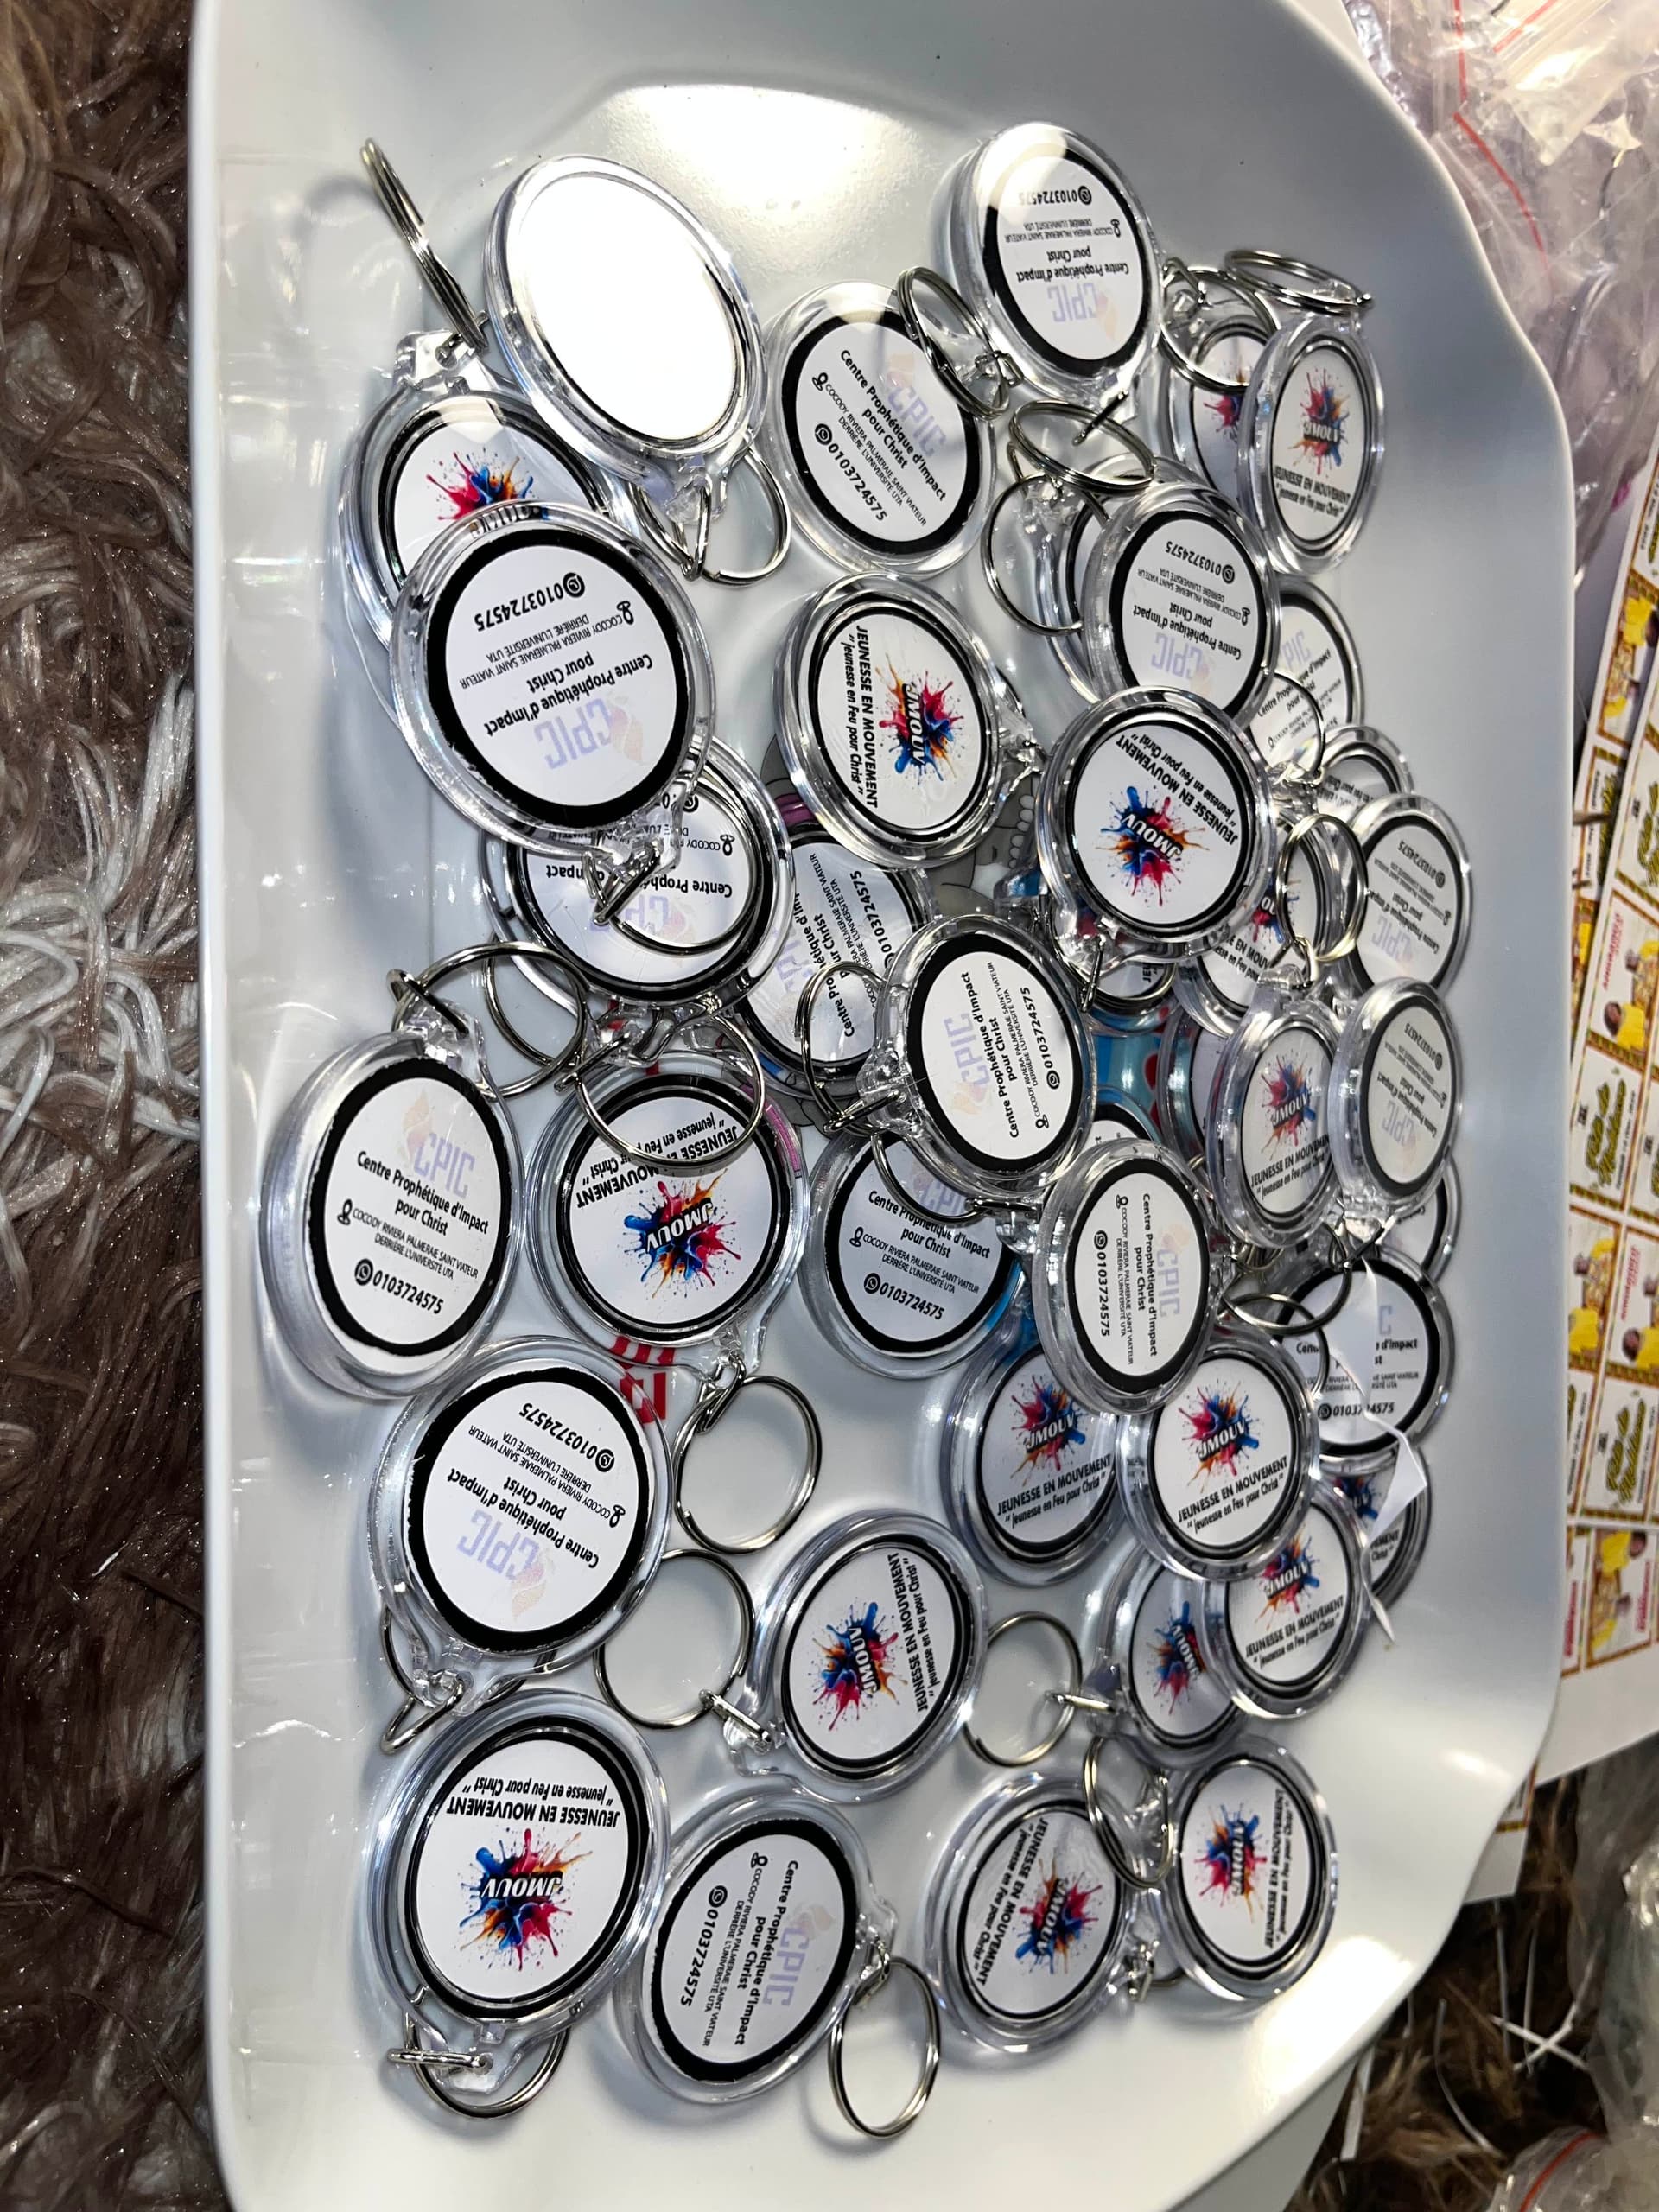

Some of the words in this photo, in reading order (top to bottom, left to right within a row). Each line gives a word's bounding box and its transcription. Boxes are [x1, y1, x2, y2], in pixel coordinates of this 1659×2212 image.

[842, 350, 868, 388] Centre
[866, 385, 913, 454] Prophétique
[912, 454, 946, 500] d'Impact
[861, 408, 885, 435] pour
[883, 435, 907, 469] Christ
[887, 389, 947, 455] CPIC
[828, 442, 887, 520] 0103724575
[474, 582, 563, 631] 0103724575
[591, 614, 622, 634] COCODY
[518, 639, 562, 664] PALMERAIE
[561, 626, 590, 645] RIVIERA
[485, 649, 504, 662] UTA
[494, 657, 518, 674] SAINT
[564, 650, 594, 675] pour
[613, 654, 652, 677] Centre
[856, 625, 872, 691] JEUNESSE
[458, 667, 494, 688] VIATEUR
[525, 667, 563, 693] Christ
[540, 669, 615, 709] Prophétique
[483, 702, 539, 736] d'Impact
[861, 695, 873, 714] EN
[535, 698, 609, 769] CPIC
[905, 683, 925, 766] JMOUV
[861, 717, 878, 808] MOUVEMENT
[1116, 730, 1180, 793] MOUVEMENT
[1178, 787, 1194, 807] EN
[1120, 811, 1182, 861] JMOUV
[1192, 800, 1238, 843] JEUNESSE
[830, 879, 840, 895] UTA
[849, 870, 892, 952] 0103724575
[814, 913, 834, 948] Christ
[961, 970, 983, 1022] d'Impact
[836, 1000, 855, 1038] Centre
[988, 1016, 1005, 1051] Christ
[1020, 987, 1053, 1068] 0103724575
[944, 1013, 989, 1084] CPIC
[979, 1025, 1007, 1097] Prophétique
[1001, 1054, 1017, 1082] pour
[1002, 1099, 1019, 1138] Centre
[680, 1126, 738, 1160] JEUNESSE
[413, 1136, 475, 1198] CPIC
[575, 1164, 659, 1208] MOUVEMENT
[589, 1157, 618, 1179] Christ
[358, 1149, 391, 1180] Centre
[391, 1168, 449, 1213] Prophétique
[450, 1203, 488, 1235] d'Impact
[393, 1198, 420, 1220] pour
[420, 1209, 448, 1236] Christ
[645, 1202, 712, 1252] JMOUV
[869, 1190, 899, 1214] Centre
[953, 1232, 989, 1259] d'Impact
[352, 1207, 381, 1229] COCODY
[380, 1222, 404, 1242] RIVIERA
[404, 1234, 438, 1258] PALMERAIE
[438, 1251, 456, 1267] SAINT
[456, 1260, 478, 1278] VIATEUR
[899, 1228, 924, 1245] pour
[925, 1236, 950, 1258] Christ
[1133, 1246, 1142, 1274] pour
[442, 1266, 454, 1279] UTA
[1144, 1233, 1154, 1304] Prophétique
[1157, 1250, 1180, 1317] CPIC
[372, 1270, 443, 1313] 0103724575
[879, 1282, 944, 1319] 0103724575
[1096, 1251, 1109, 1337] 0103724575
[1136, 1276, 1145, 1311] Christ
[1147, 1306, 1158, 1357] d'Impact
[468, 1425, 498, 1449] VIATEUR
[502, 1431, 517, 1446] UTA
[518, 1402, 597, 1459] 0103724575
[497, 1444, 519, 1462] SAINT
[518, 1456, 558, 1485] PALMERAIE
[447, 1467, 498, 1507] d'Impact
[503, 1476, 537, 1505] Christ
[557, 1479, 582, 1501] RIVIERA
[997, 1485, 1041, 1516] JEUNESSE
[1042, 1478, 1055, 1496] EN
[1057, 1454, 1113, 1490] MOUVEMENT
[1178, 1491, 1220, 1523] JEUNESSE
[1220, 1484, 1234, 1500] EN
[1235, 1456, 1290, 1493] MOUVEMENT
[498, 1497, 565, 1548] Prophétique
[537, 1497, 567, 1520] pour
[582, 1496, 610, 1518] COCODY
[456, 1510, 538, 1575] CPIC
[565, 1538, 599, 1568] Centre
[887, 1548, 913, 1633] MOUVEMENT
[906, 1563, 919, 1592] Christ
[913, 1592, 927, 1615] pour
[904, 1633, 917, 1654] EN
[917, 1615, 928, 1635] Feu
[921, 1633, 931, 1646] en
[848, 1625, 877, 1694] JMOUV
[924, 1647, 941, 1688] jeunesse
[907, 1652, 929, 1712] JEUNESSE
[473, 1777, 503, 1796] Christ
[505, 1777, 531, 1793] pour
[531, 1782, 550, 1800] Feu
[550, 1784, 563, 1796] en
[565, 1784, 607, 1805] jeunesse
[446, 1794, 537, 1821] MOUVEMENT
[538, 1804, 557, 1822] EN
[559, 1806, 620, 1827] JEUNESSE
[1018, 1817, 1048, 1878] JEUNESSE
[479, 1875, 562, 1898] JMOUV
[778, 1861, 798, 1902] Centre
[1009, 1879, 1025, 1899] EN
[750, 1916, 766, 1948] pour
[753, 1905, 785, 1985] Prophétique
[973, 1900, 1016, 1985] MOUVEMENT
[680, 1909, 718, 2006] 0103724575
[736, 1950, 757, 1989] Christ
[763, 1928, 806, 2005] CPIC
[734, 1987, 760, 2044] d'Impact
